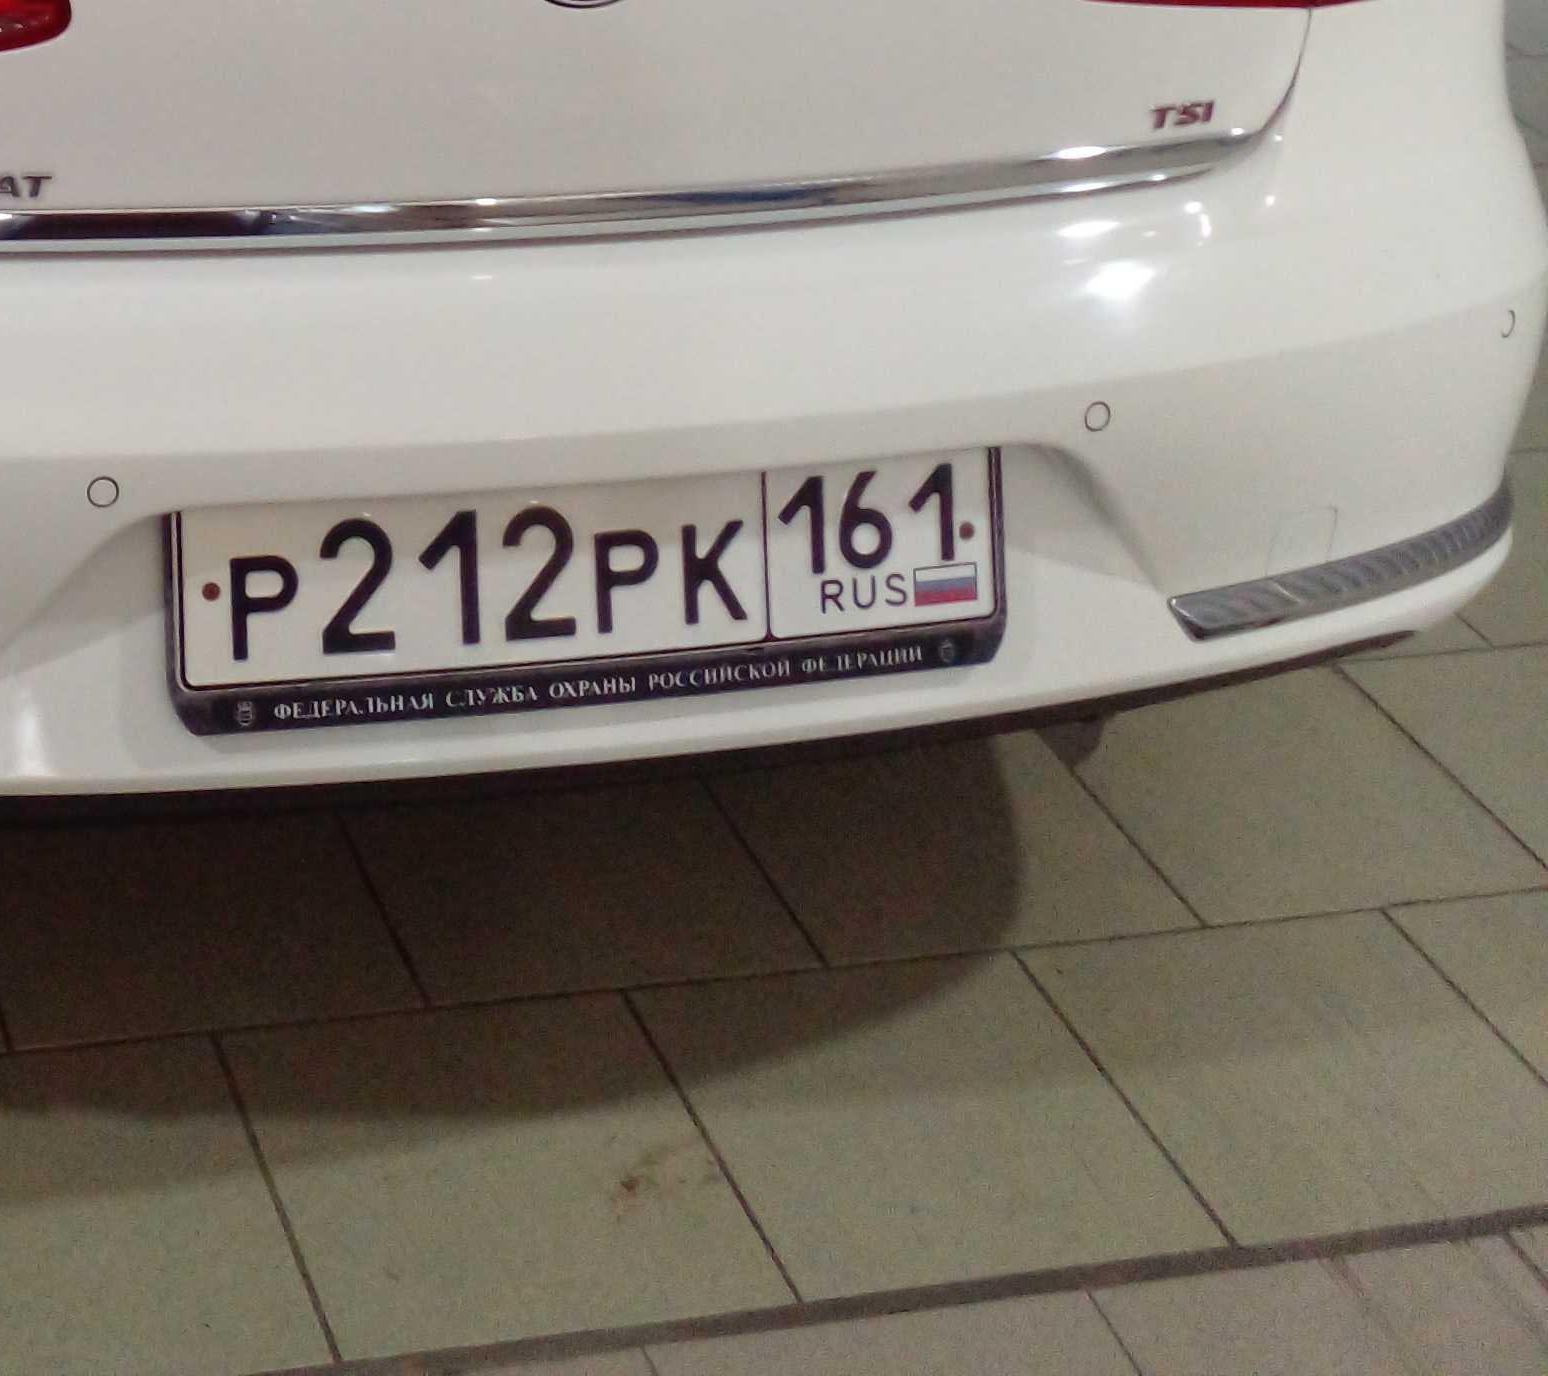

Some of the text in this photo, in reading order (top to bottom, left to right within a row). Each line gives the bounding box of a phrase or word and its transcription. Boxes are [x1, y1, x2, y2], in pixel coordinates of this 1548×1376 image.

[1150, 99, 1215, 129] TSI
[777, 461, 957, 576] 161
[819, 573, 908, 614] RUS
[274, 691, 434, 721] ФЕДЕРАЛЬНАЯ
[445, 684, 540, 709] СЛУЖБА
[548, 676, 637, 699] ОХРАНЫ
[648, 659, 791, 690] РОССИЙСКОЙ
